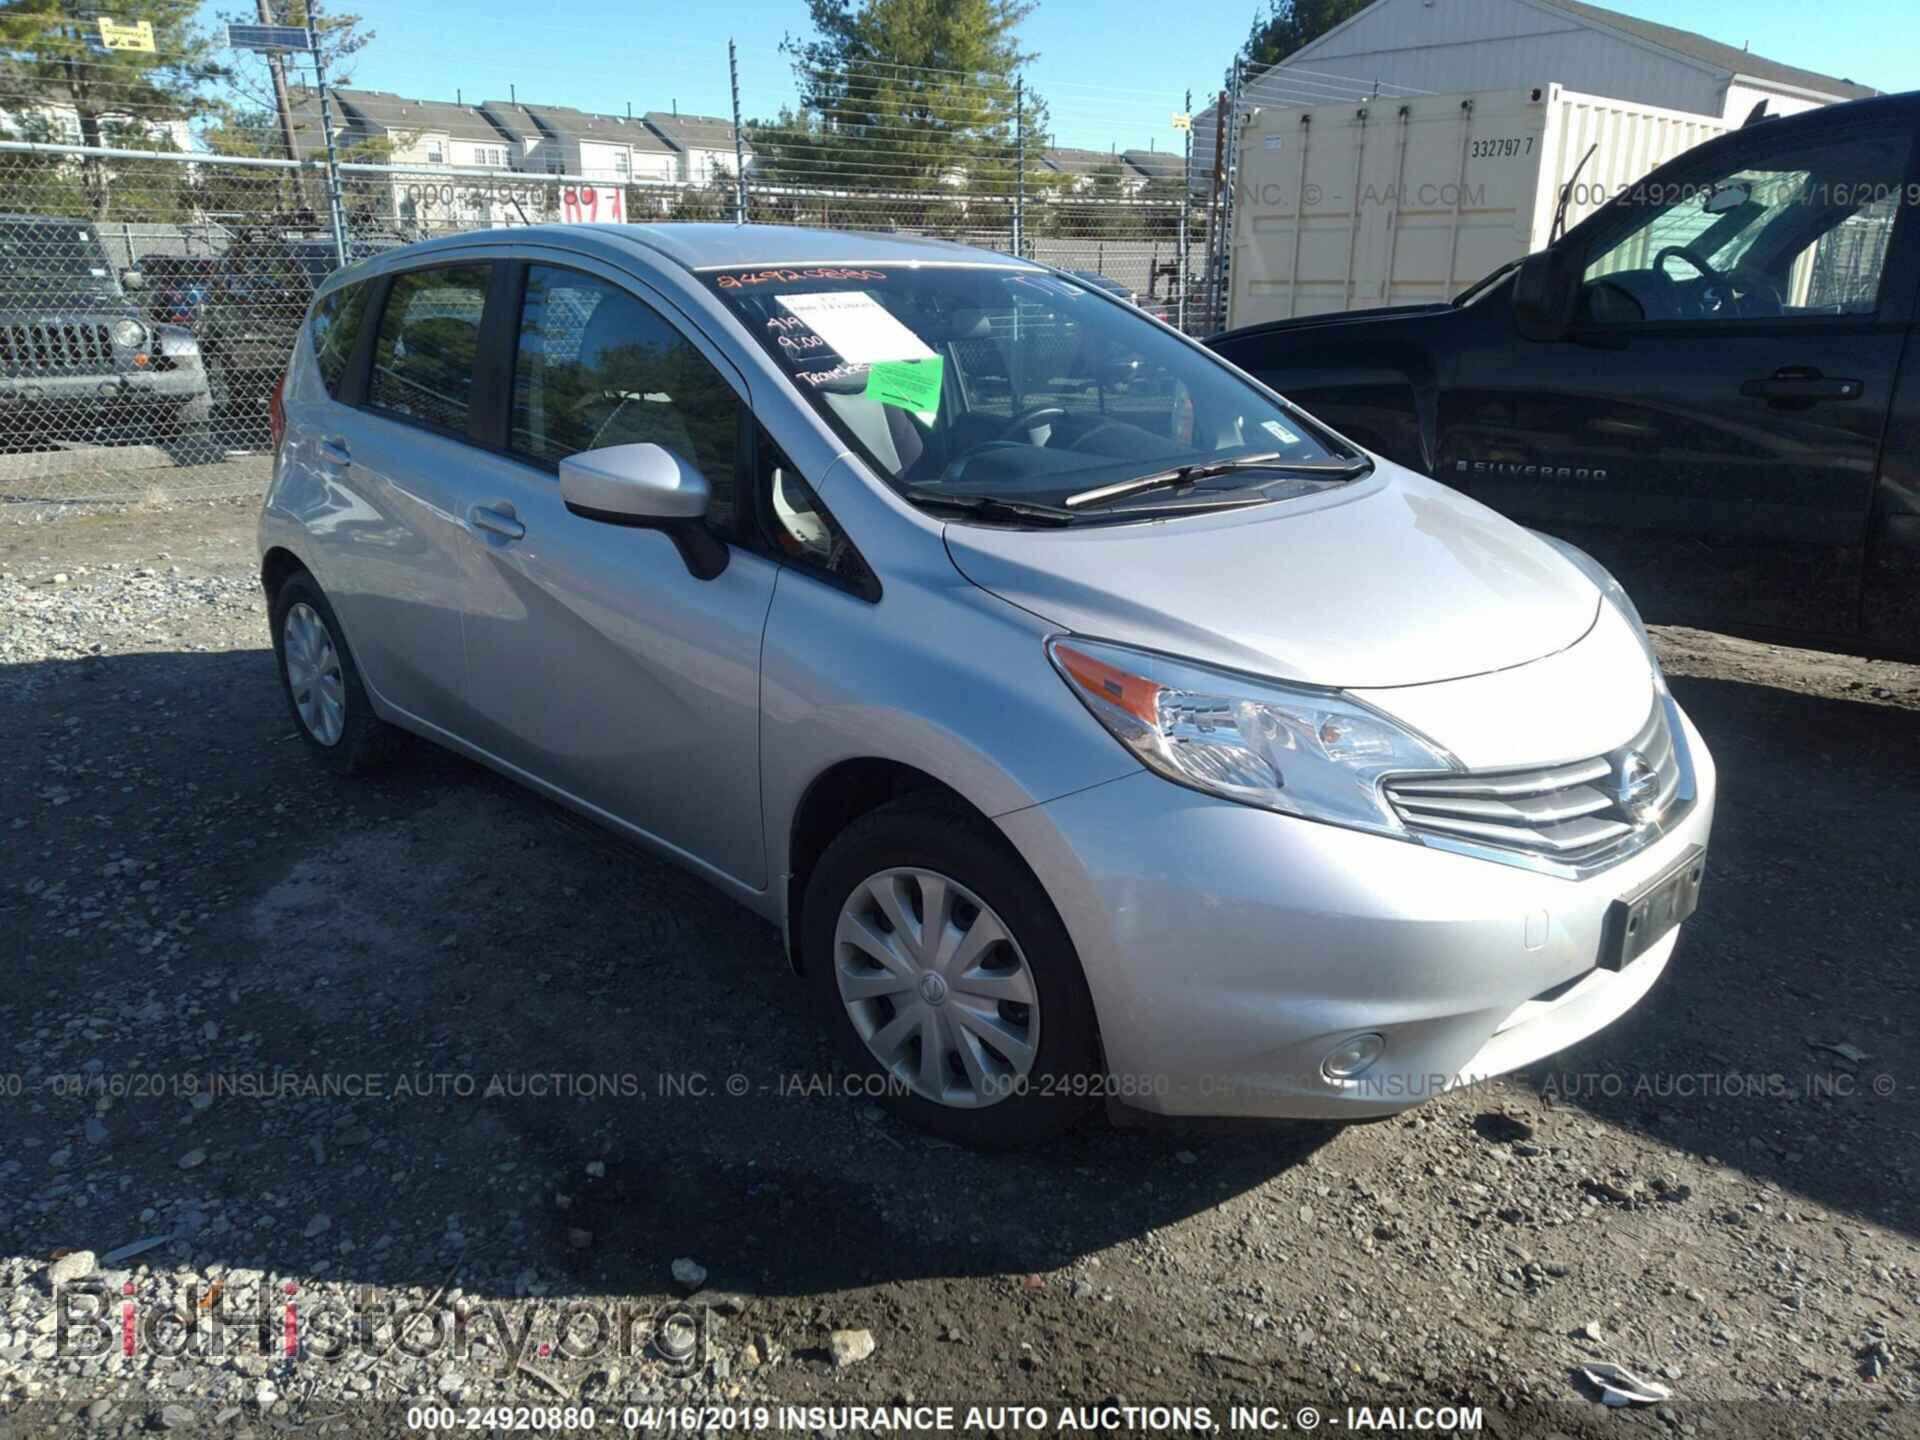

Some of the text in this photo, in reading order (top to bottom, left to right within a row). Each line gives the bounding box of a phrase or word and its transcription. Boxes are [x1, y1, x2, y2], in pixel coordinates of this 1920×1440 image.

[1471, 136, 1534, 158] 332797 7
[717, 268, 887, 289] 24920880
[1473, 461, 1607, 481] SILVERADO
